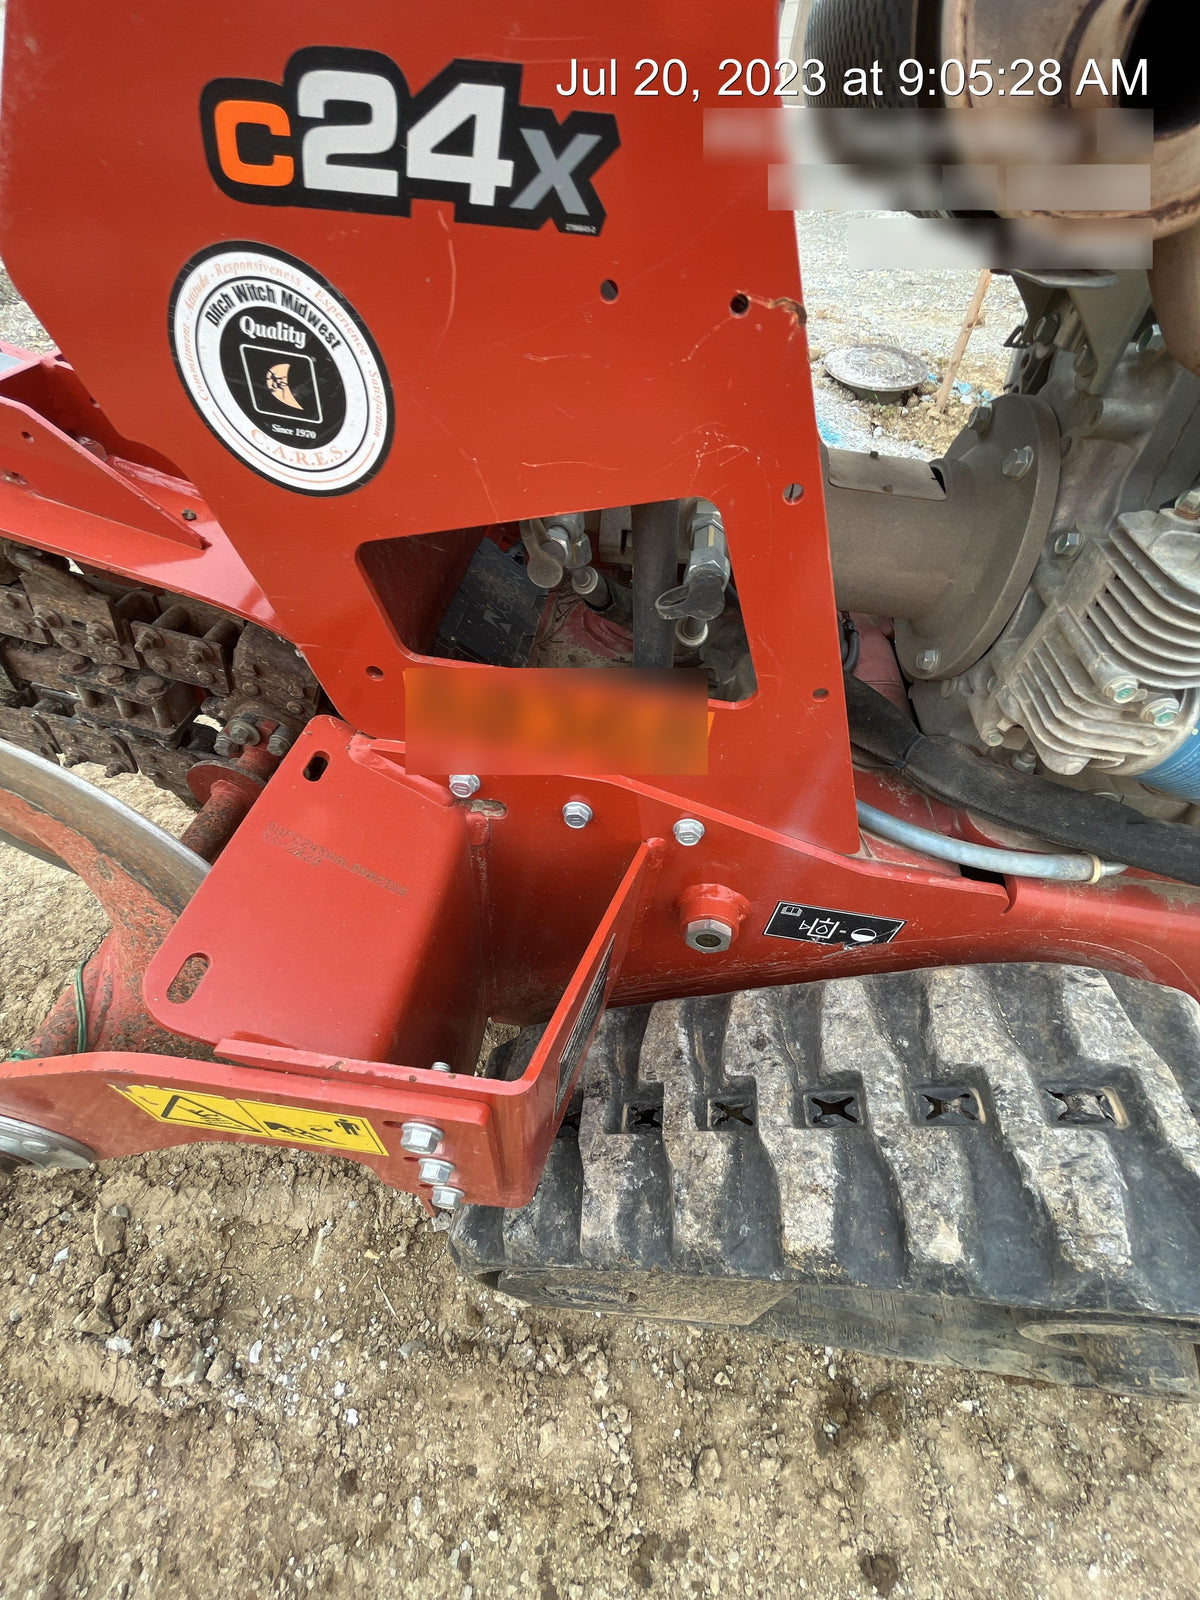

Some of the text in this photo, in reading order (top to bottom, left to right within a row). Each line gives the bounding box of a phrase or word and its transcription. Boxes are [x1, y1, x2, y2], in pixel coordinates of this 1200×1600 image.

[204, 282, 343, 351] Ditch Witch Midwest
[214, 259, 303, 287] Responsiveness
[313, 288, 368, 356] Experience
[238, 315, 307, 349] Quality
[271, 423, 317, 440] Since 1970
